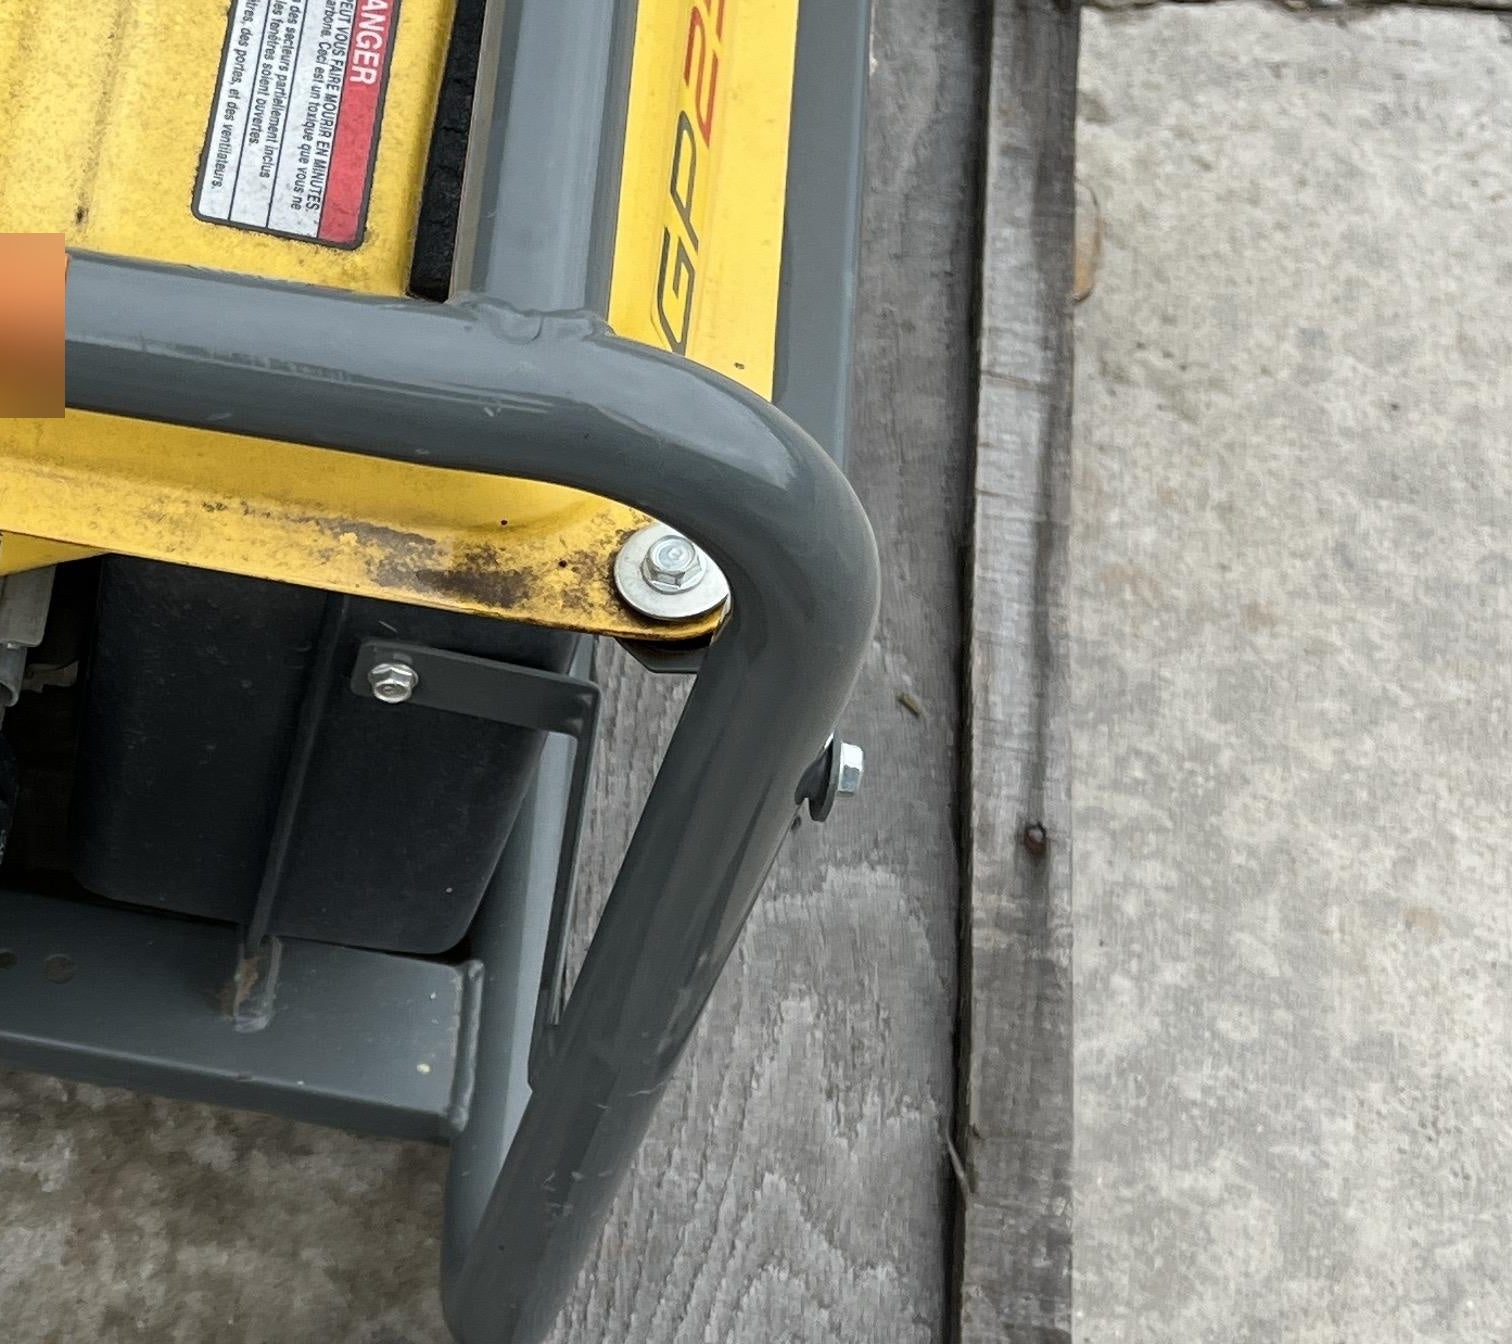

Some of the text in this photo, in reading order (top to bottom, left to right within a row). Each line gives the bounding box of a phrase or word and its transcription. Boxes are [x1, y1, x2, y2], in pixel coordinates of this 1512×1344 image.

[271, 0, 287, 16] les
[286, 4, 301, 24] des
[237, 26, 253, 47] des
[278, 26, 296, 71] secteurs
[331, 26, 349, 56] VOUS
[229, 47, 247, 85] portes,
[315, 40, 332, 65] Ceci
[256, 62, 273, 96] soient
[312, 65, 325, 84] est
[325, 58, 344, 91] FAIRE
[227, 87, 241, 100] et
[309, 84, 321, 100] un
[223, 100, 238, 121] des
[248, 97, 267, 144] ouvertes.
[265, 73, 287, 143] partiellement
[301, 101, 320, 141] toxique
[318, 92, 337, 138] MOURIR
[210, 123, 232, 188] ventilateurs.
[258, 144, 277, 178] inclus
[297, 142, 312, 164] que
[314, 139, 330, 157] EN
[293, 166, 307, 193] vous
[305, 158, 326, 211] MINUTES.
[290, 195, 303, 210] ne
